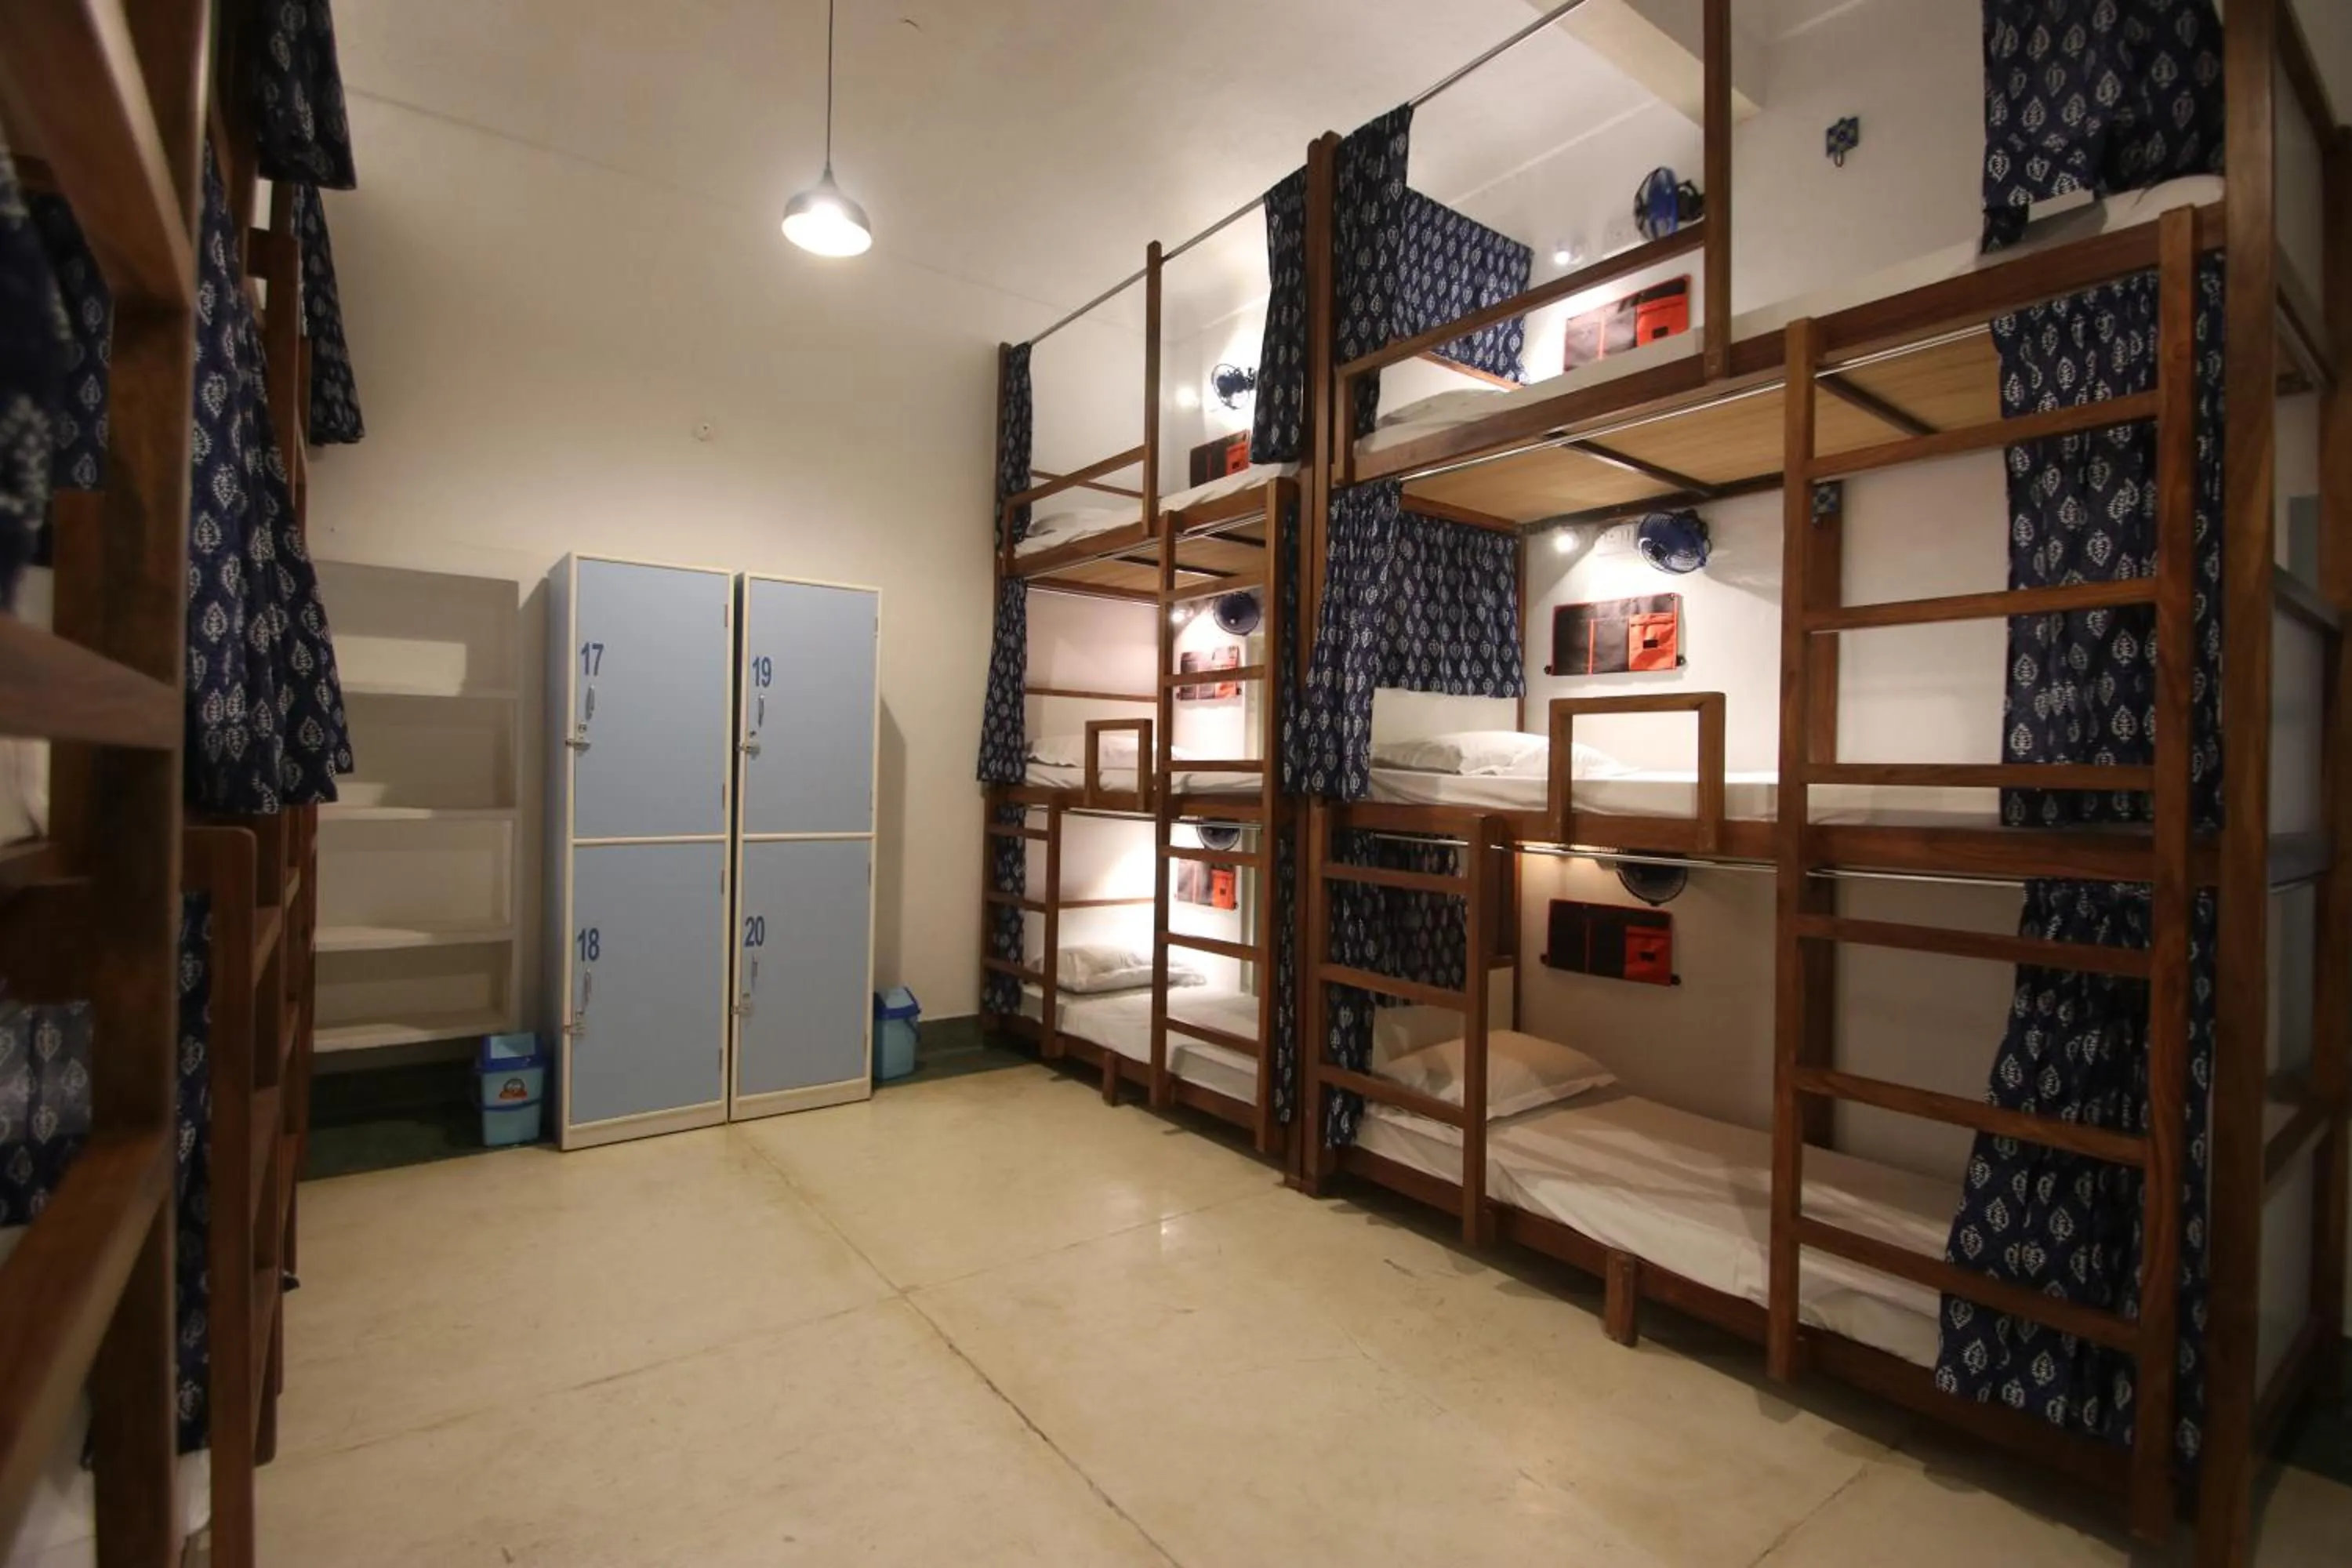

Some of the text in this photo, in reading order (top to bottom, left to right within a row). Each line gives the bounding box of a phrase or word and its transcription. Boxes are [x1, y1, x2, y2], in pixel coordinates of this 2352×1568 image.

[580, 641, 604, 677] 17
[752, 656, 772, 688] 19
[577, 927, 601, 963] 18
[744, 915, 765, 947] 20
